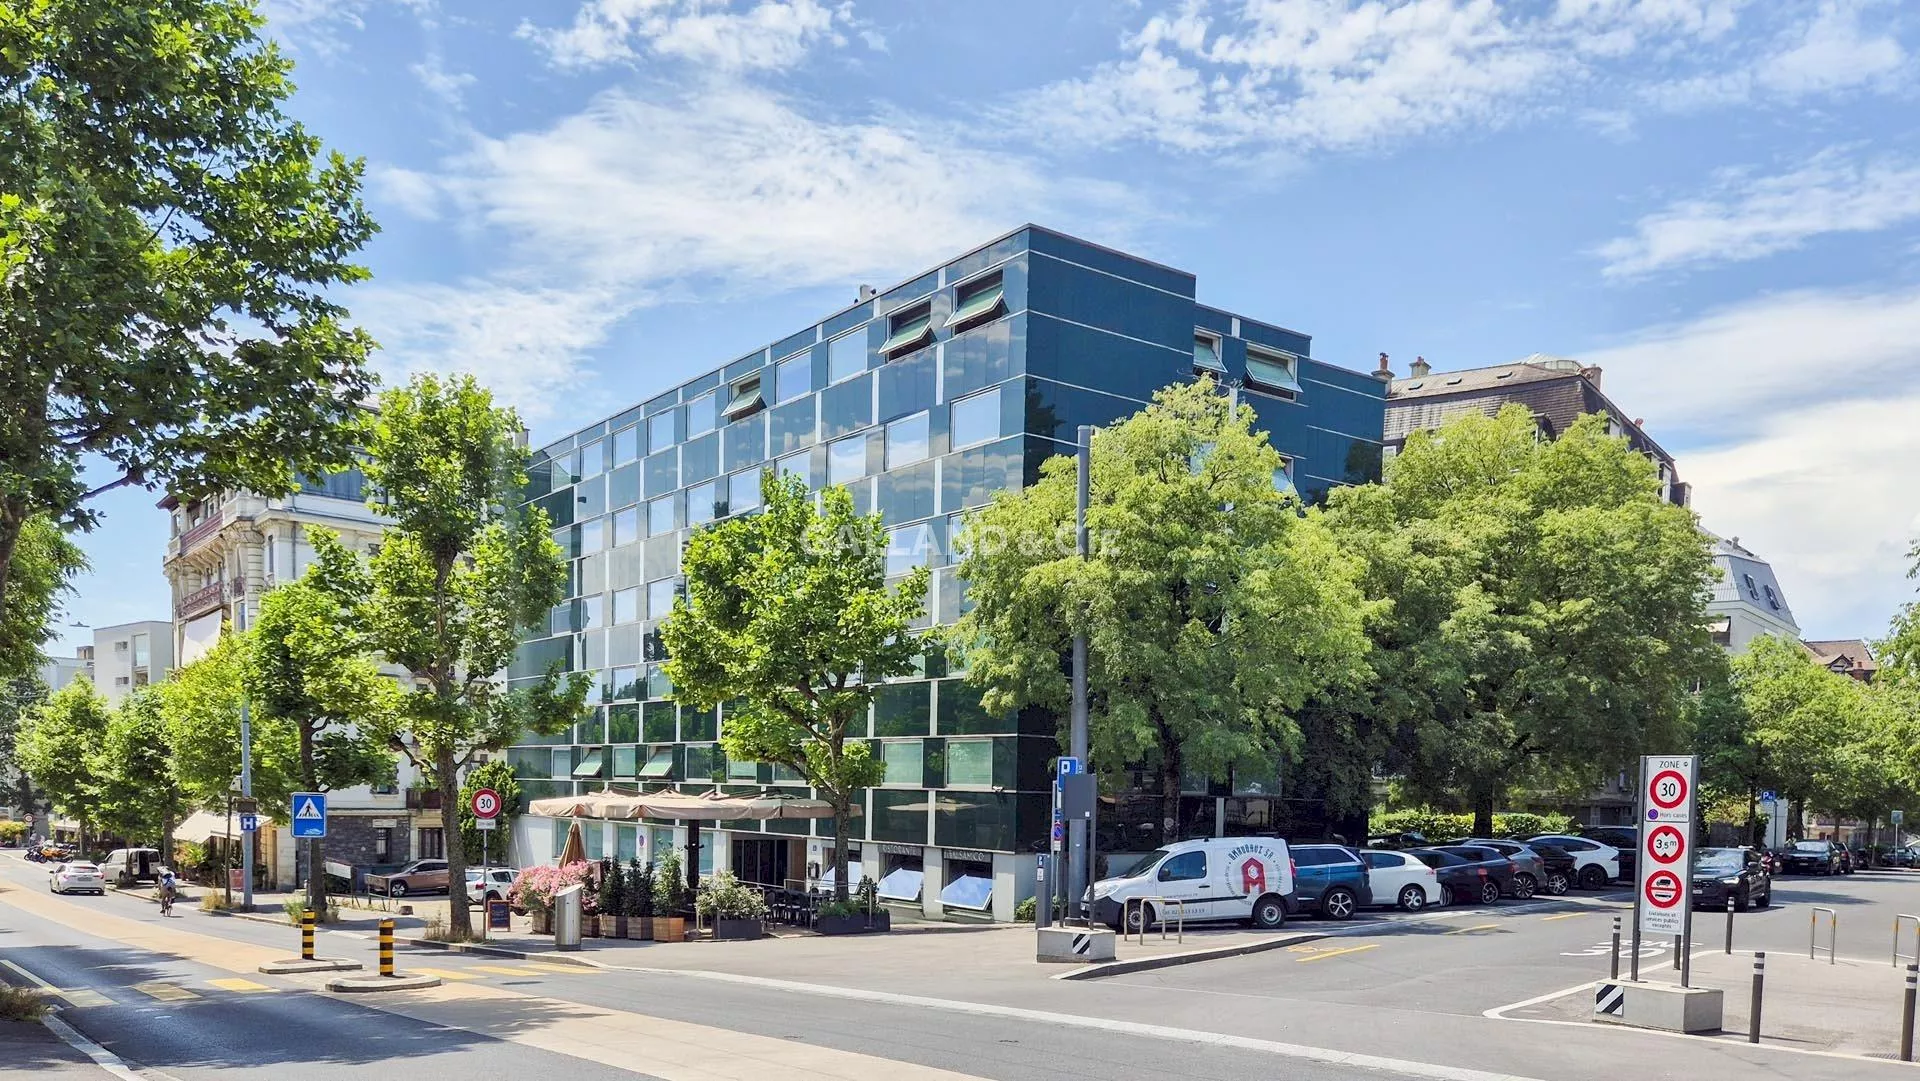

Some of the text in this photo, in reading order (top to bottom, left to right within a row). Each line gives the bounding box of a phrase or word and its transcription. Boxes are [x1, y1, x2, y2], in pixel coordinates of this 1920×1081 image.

[1659, 760, 1680, 769] ZONE
[1661, 782, 1676, 797] 30
[480, 798, 492, 809] 30
[243, 819, 254, 830] H
